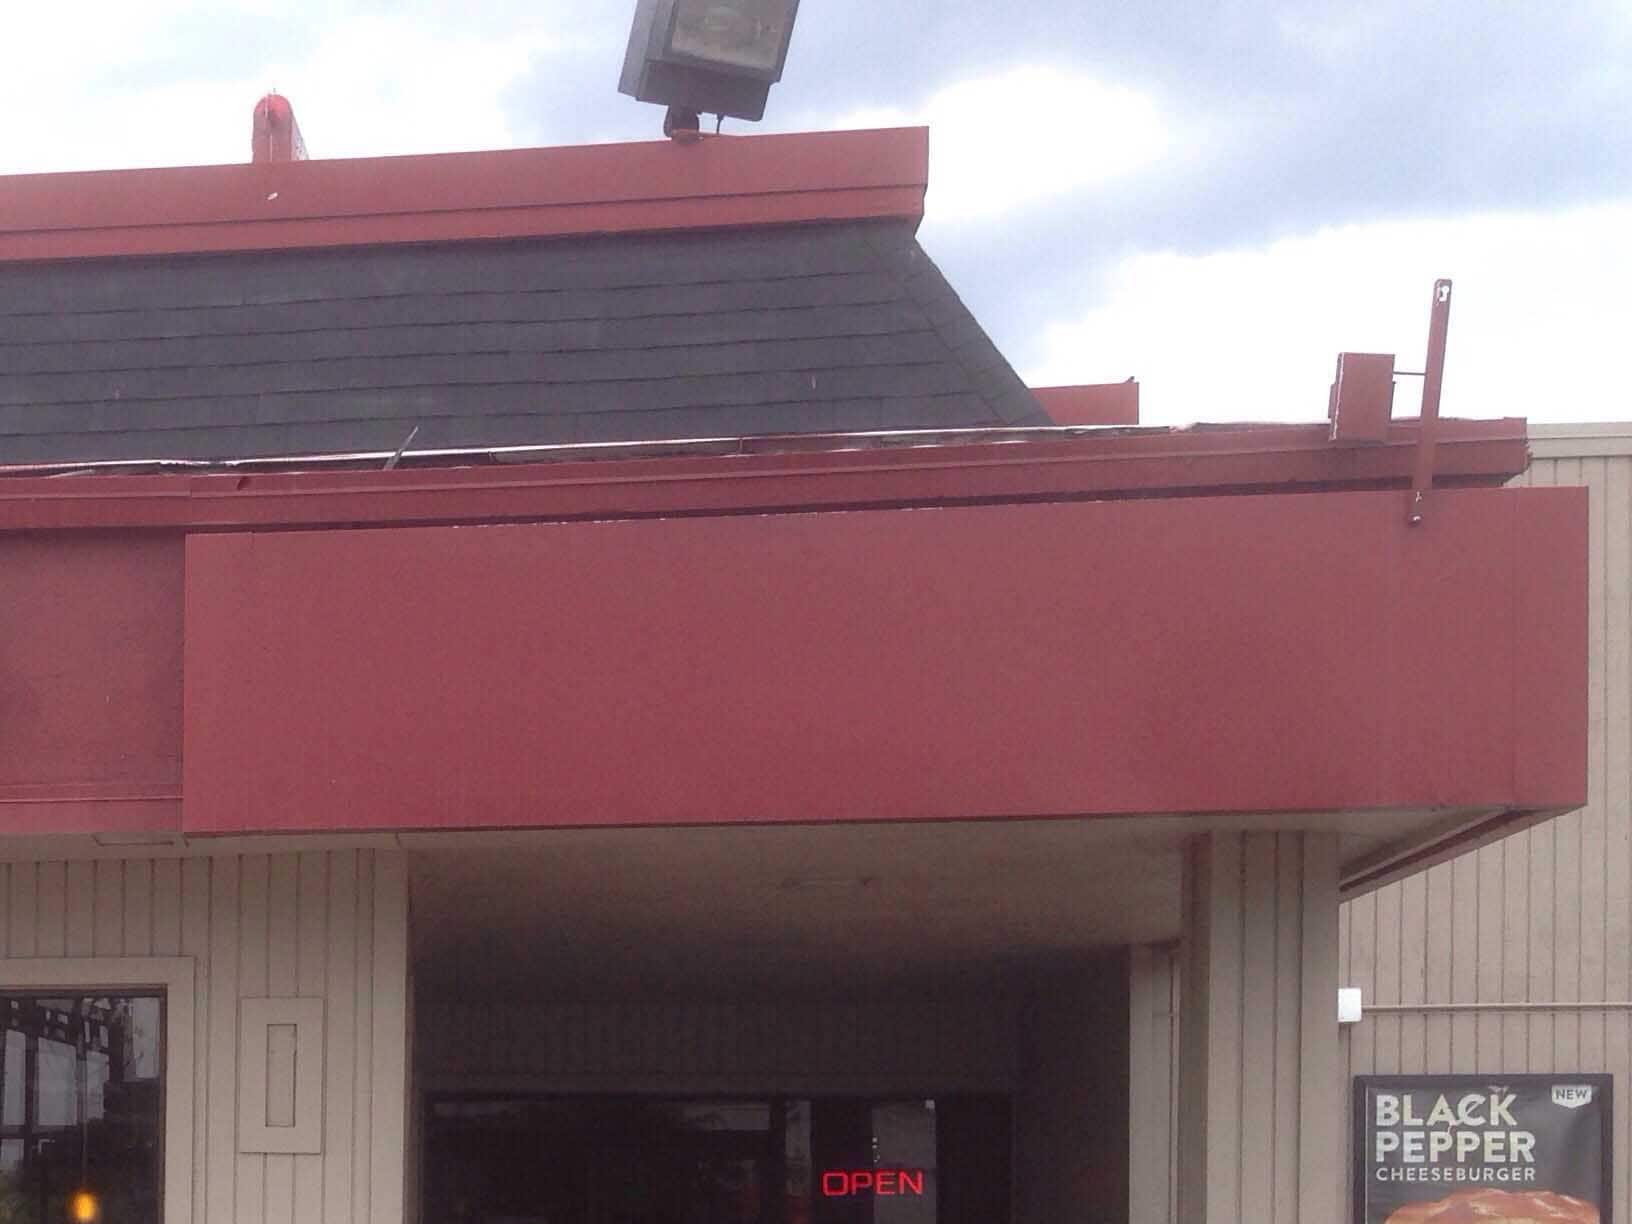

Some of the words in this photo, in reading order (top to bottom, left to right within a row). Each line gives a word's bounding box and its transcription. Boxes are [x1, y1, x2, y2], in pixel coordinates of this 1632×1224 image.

[1555, 1088, 1587, 1100] NEW
[1375, 1093, 1518, 1127] BLACK
[1375, 1131, 1536, 1163] PEPPER
[821, 1170, 924, 1196] OPEN
[1375, 1167, 1536, 1182] CHEESEBURGER
